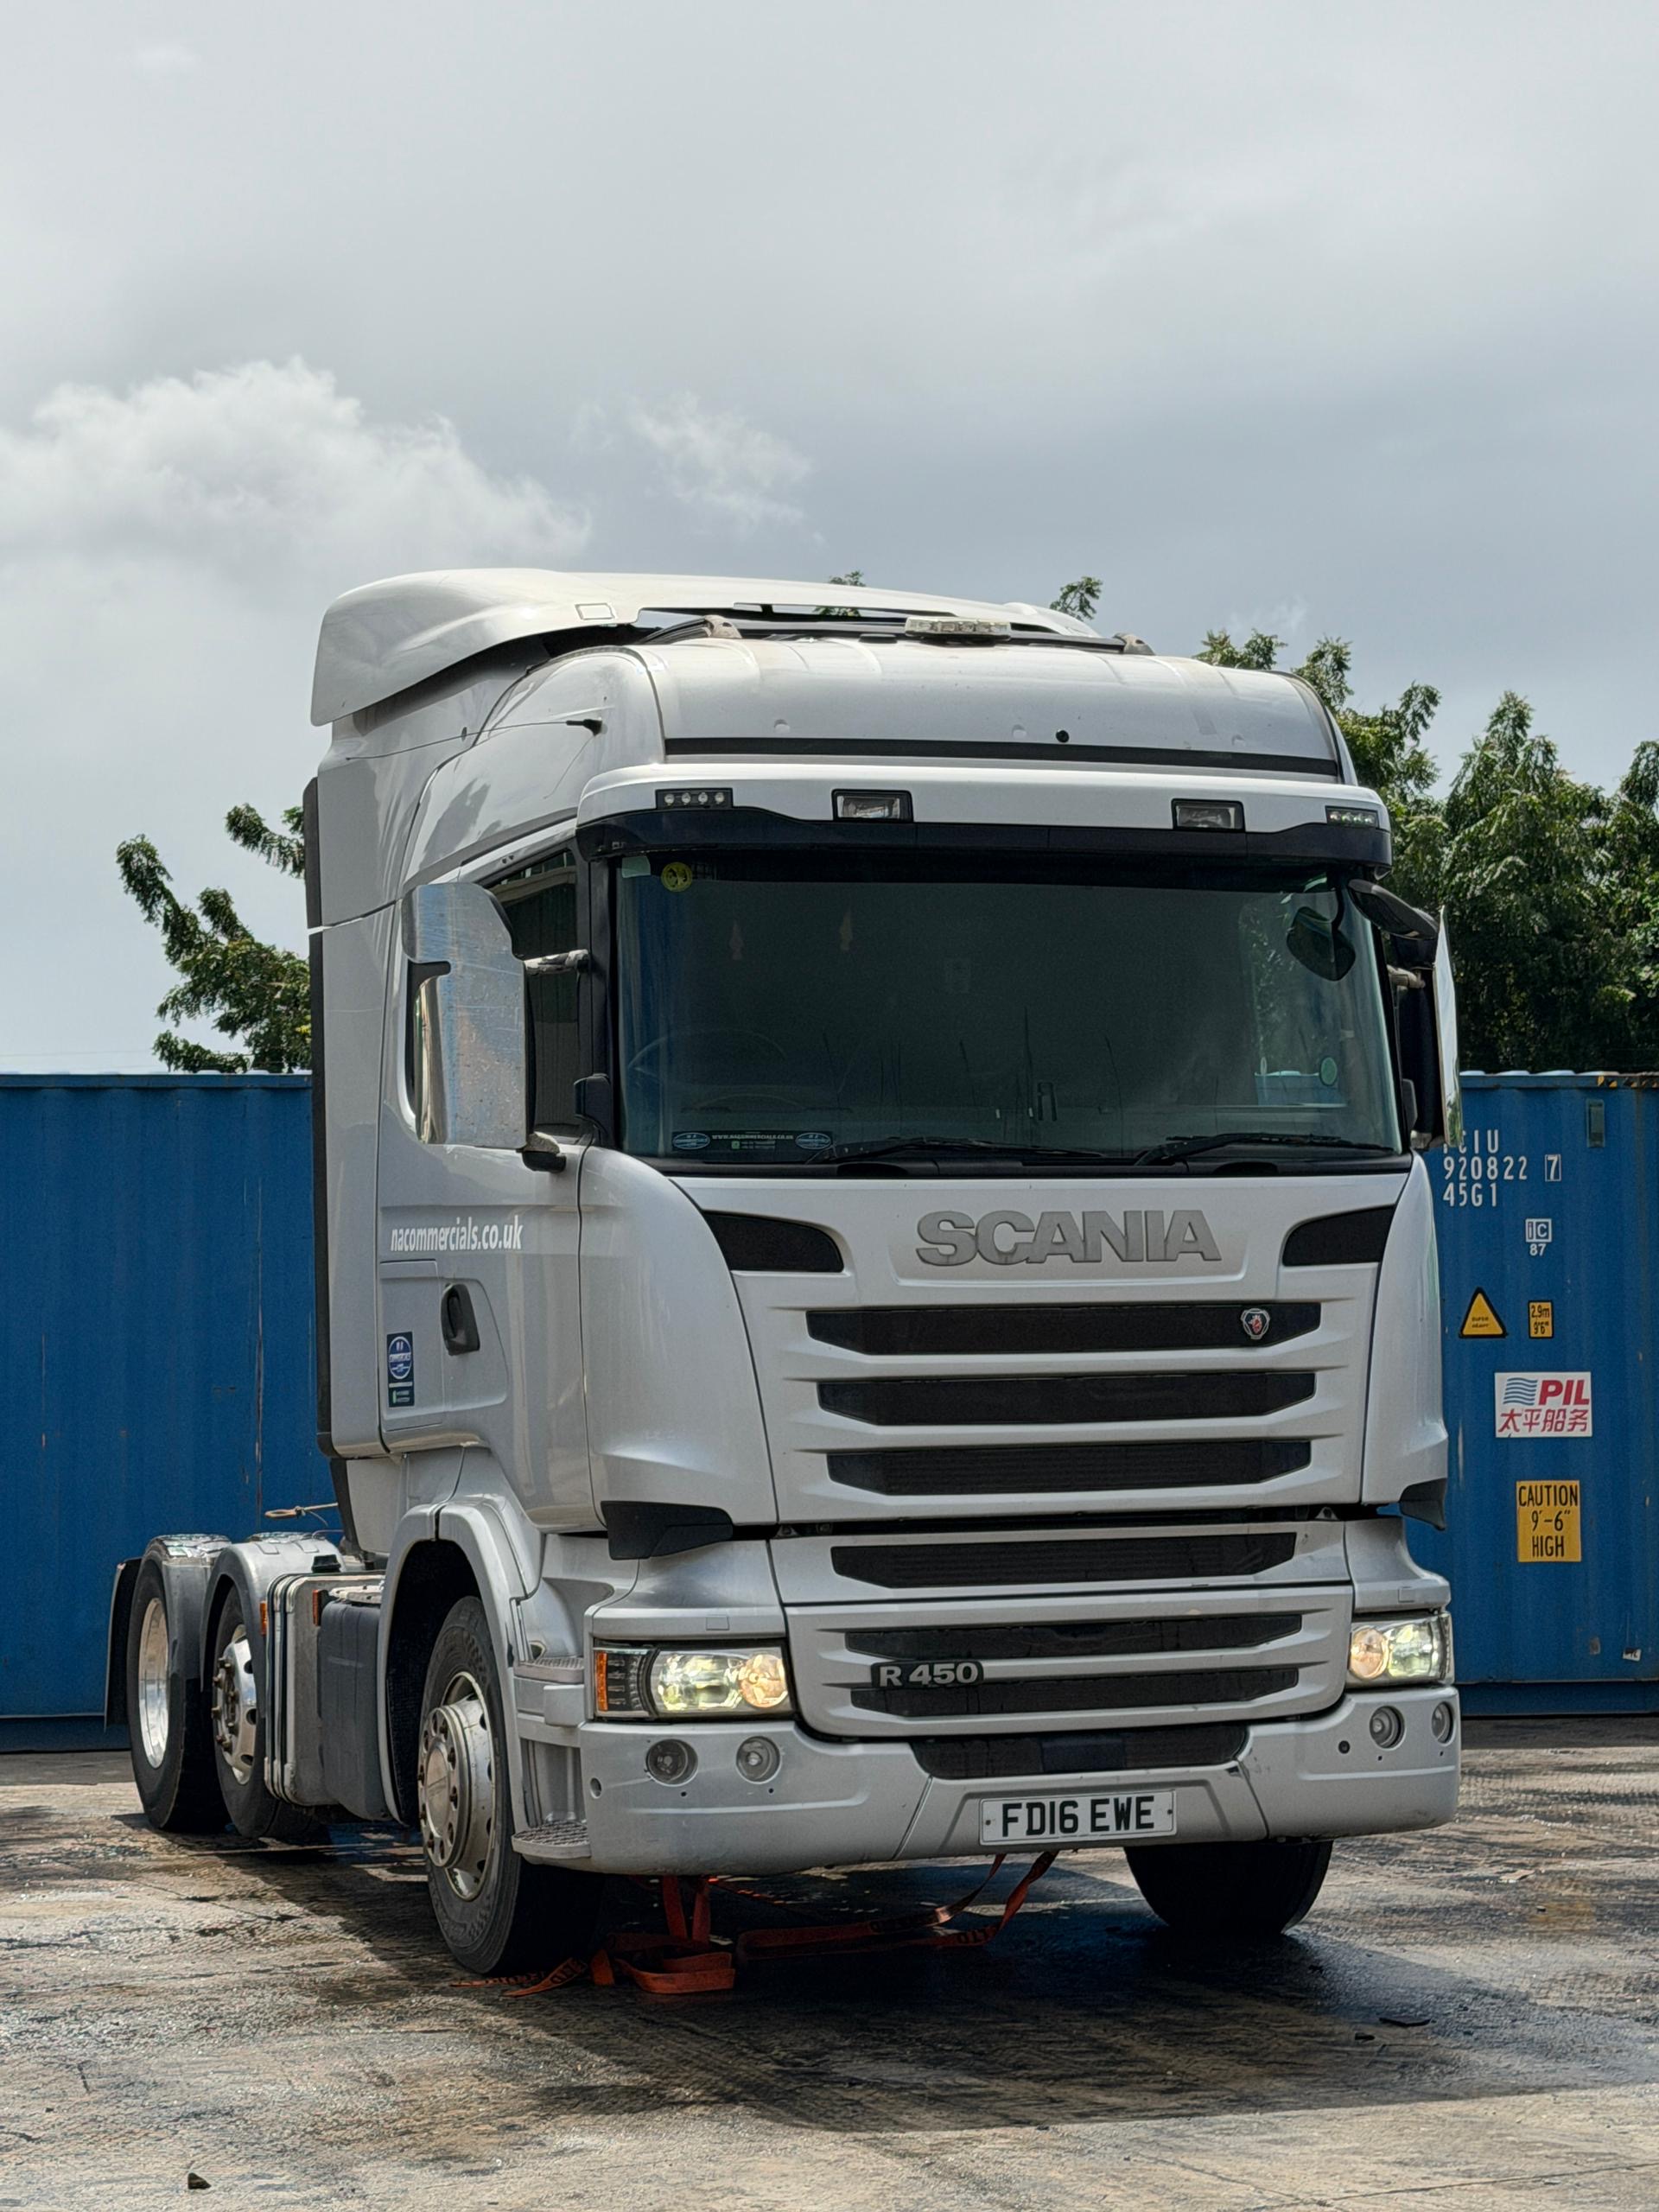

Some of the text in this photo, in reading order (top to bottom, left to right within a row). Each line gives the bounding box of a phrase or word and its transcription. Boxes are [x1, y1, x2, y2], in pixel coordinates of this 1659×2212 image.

[1443, 1155, 1559, 1180] 920822 7
[1443, 1183, 1497, 1207] 45G1
[391, 1215, 524, 1252] nacommercials.co.uk
[916, 1210, 1222, 1267] SCANIA
[1529, 1243, 1547, 1256] 87
[1531, 1304, 1550, 1319] 2.9m
[1539, 1379, 1590, 1406] PIL
[1497, 1408, 1589, 1433] 太平船务
[1518, 1484, 1578, 1507] CAUTION
[1532, 1535, 1564, 1558] HIGH
[880, 1662, 979, 1687] R 450
[1001, 1796, 1155, 1837] FD16 EWE
